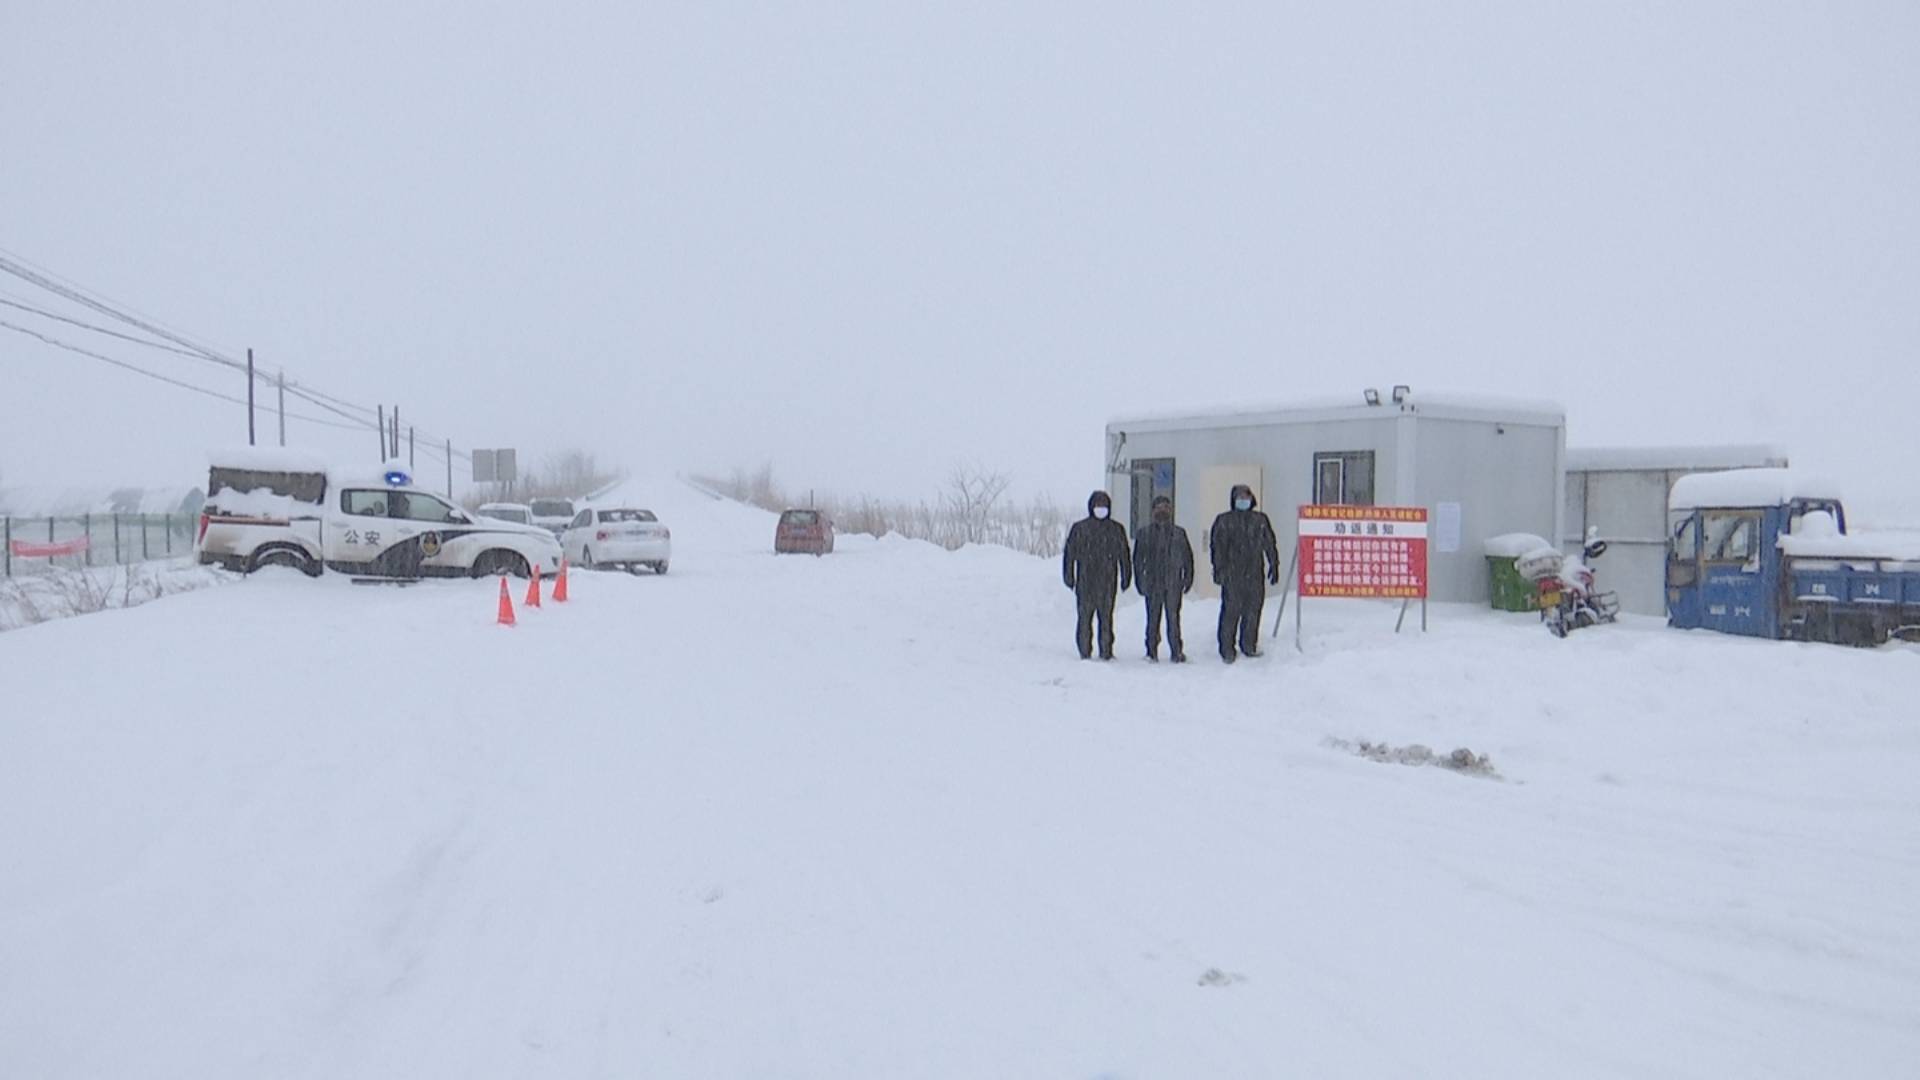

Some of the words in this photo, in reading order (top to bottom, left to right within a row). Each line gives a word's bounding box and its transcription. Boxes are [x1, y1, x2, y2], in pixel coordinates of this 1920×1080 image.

[1334, 522, 1394, 535] 劝返通知
[344, 529, 381, 546] 公安
